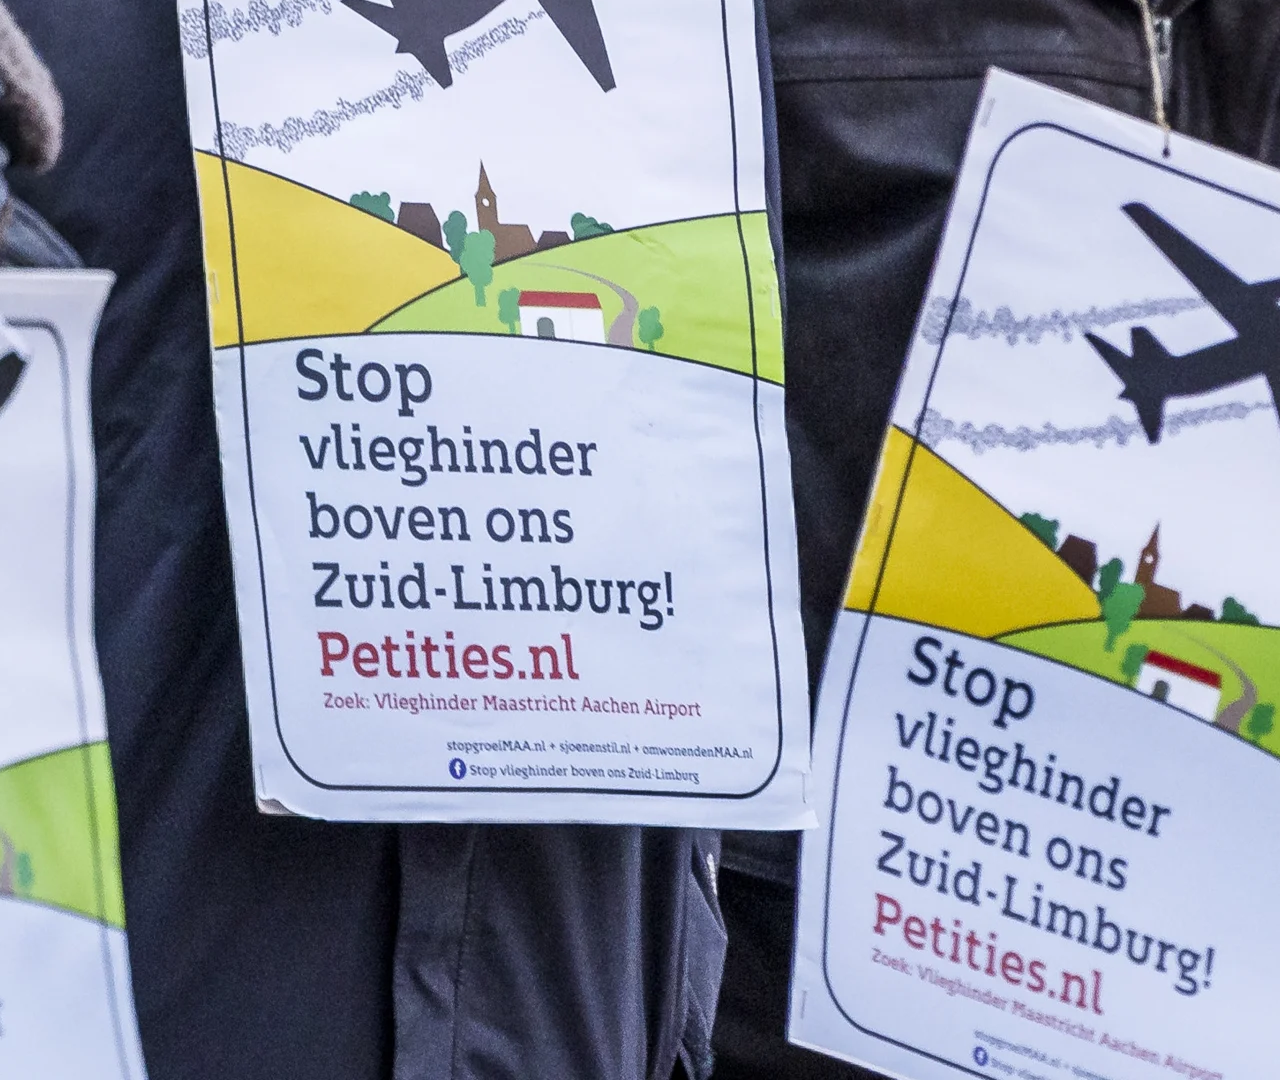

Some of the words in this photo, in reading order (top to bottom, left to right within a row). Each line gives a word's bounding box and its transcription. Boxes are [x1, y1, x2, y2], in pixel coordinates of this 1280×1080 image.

[295, 348, 432, 417] Stop
[300, 424, 597, 487] vlieghinder
[305, 492, 471, 542] boven
[486, 506, 574, 544] ons
[313, 561, 675, 631] Zuid-Limburg!
[317, 631, 580, 681] Petities.nl
[907, 636, 1035, 728] Stop
[323, 692, 370, 710] Zoek:
[373, 692, 478, 715] Vlieghinder
[482, 693, 577, 712] Maastricht
[581, 696, 640, 715] Aachen
[644, 698, 702, 720] Airport
[446, 739, 546, 755] stopgroeiMAA.nl
[642, 745, 753, 760] omwonendenMAA.nl
[469, 764, 498, 779] Stop
[500, 763, 568, 780] vlieghinder
[570, 765, 605, 778] boven
[607, 768, 626, 779] ons
[627, 767, 700, 785] Zuid-Limburg
[895, 711, 1173, 838] vlieghinder
[883, 765, 1030, 859] boven
[1046, 834, 1129, 891] ons
[877, 831, 1215, 997] Zuid-Limburg!
[872, 892, 1105, 1016] Petities.nl
